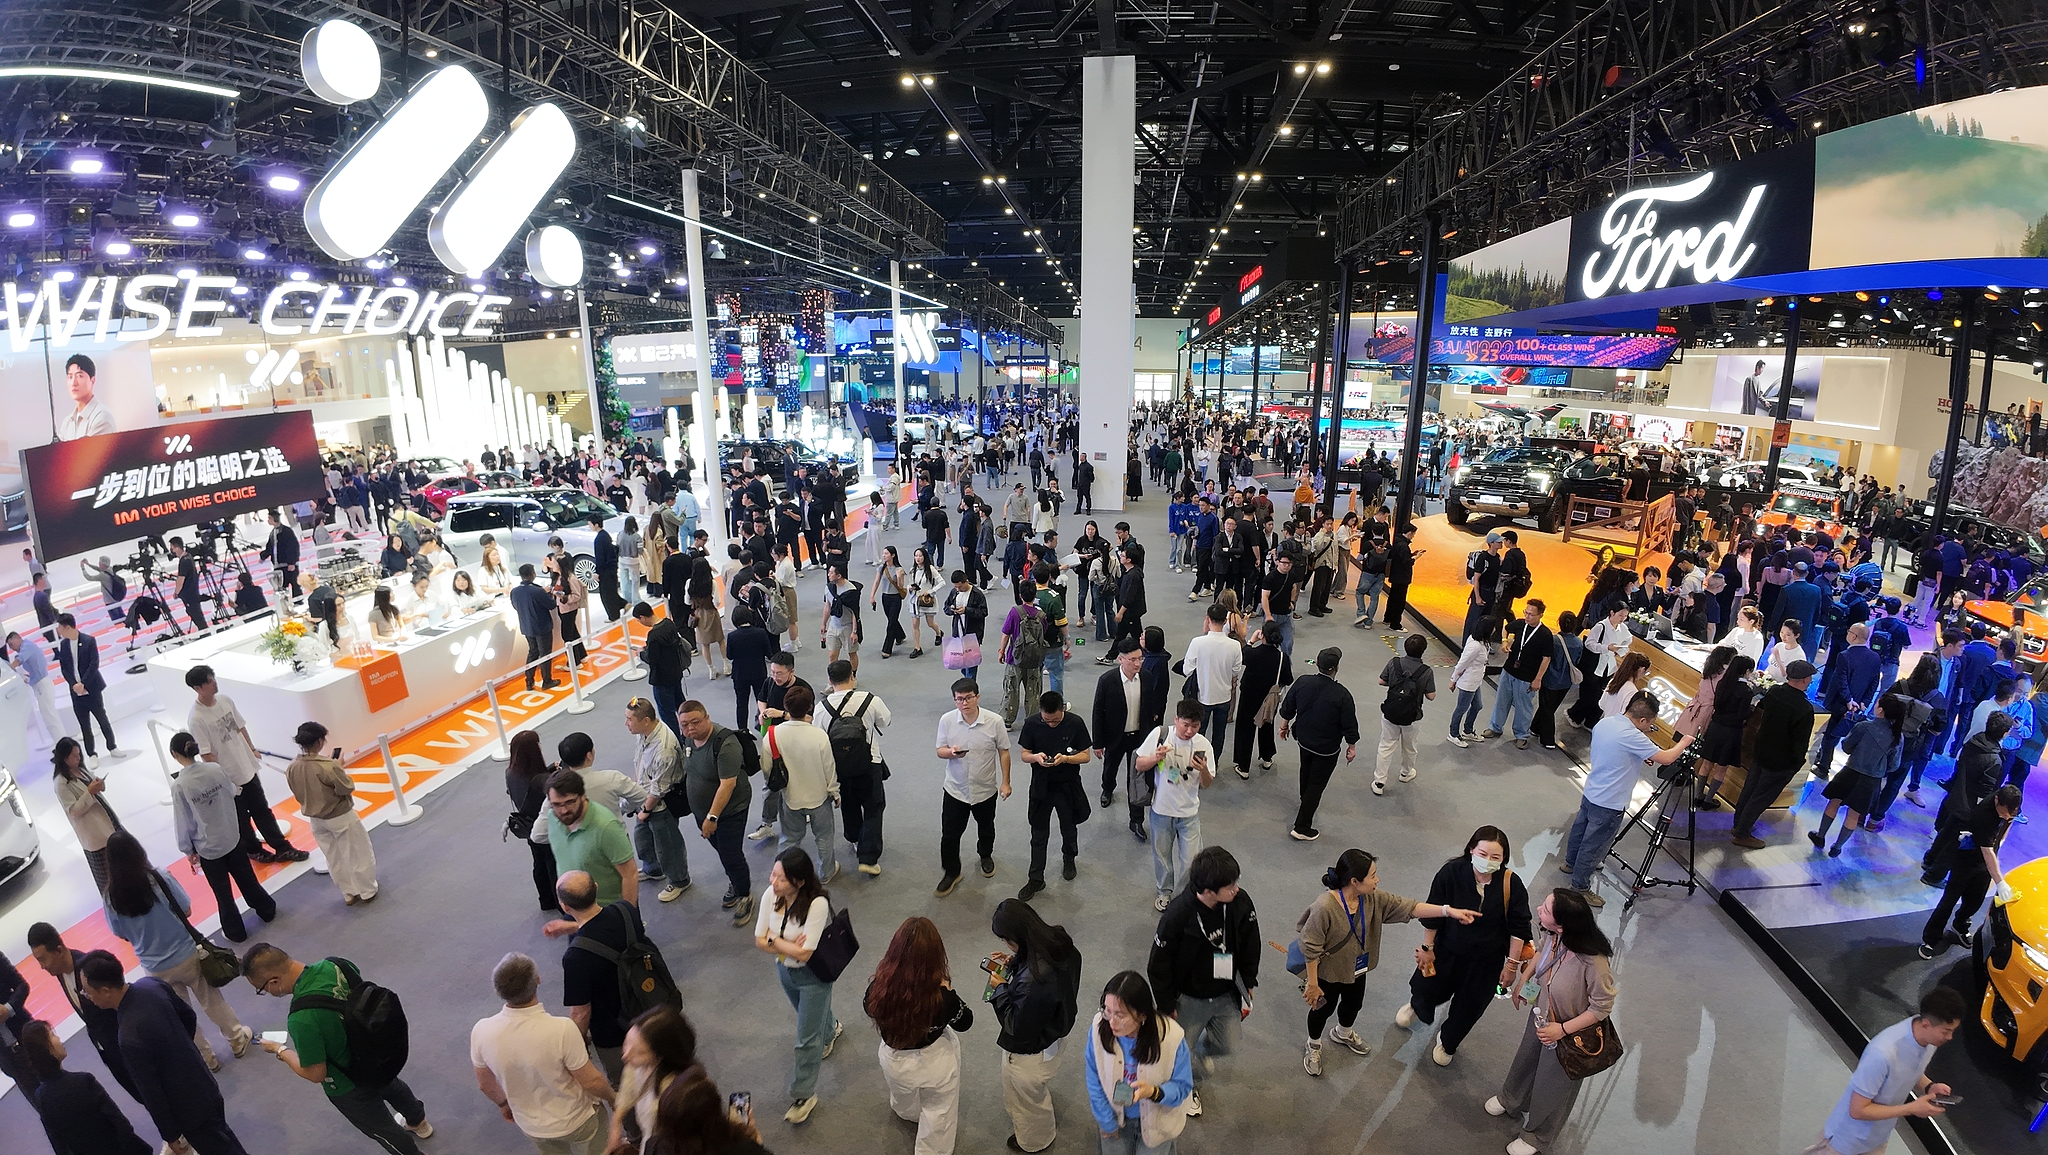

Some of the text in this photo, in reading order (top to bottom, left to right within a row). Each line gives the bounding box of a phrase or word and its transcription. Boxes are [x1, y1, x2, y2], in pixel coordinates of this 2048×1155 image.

[1582, 171, 1767, 299] Ford
[4, 274, 512, 351] WISE CHOICE
[1450, 326, 1512, 338] 放天性 去野行
[1656, 325, 1677, 334] NDA
[1433, 339, 1514, 355] BAJA1000
[1574, 344, 1596, 352] WINS
[1479, 349, 1499, 362] 23
[1533, 354, 1555, 362] WINS
[1937, 398, 1975, 412] HODA
[72, 446, 290, 509] 一步到位的聪明之选
[113, 485, 257, 526] IM YOUR WISE CHOICE
